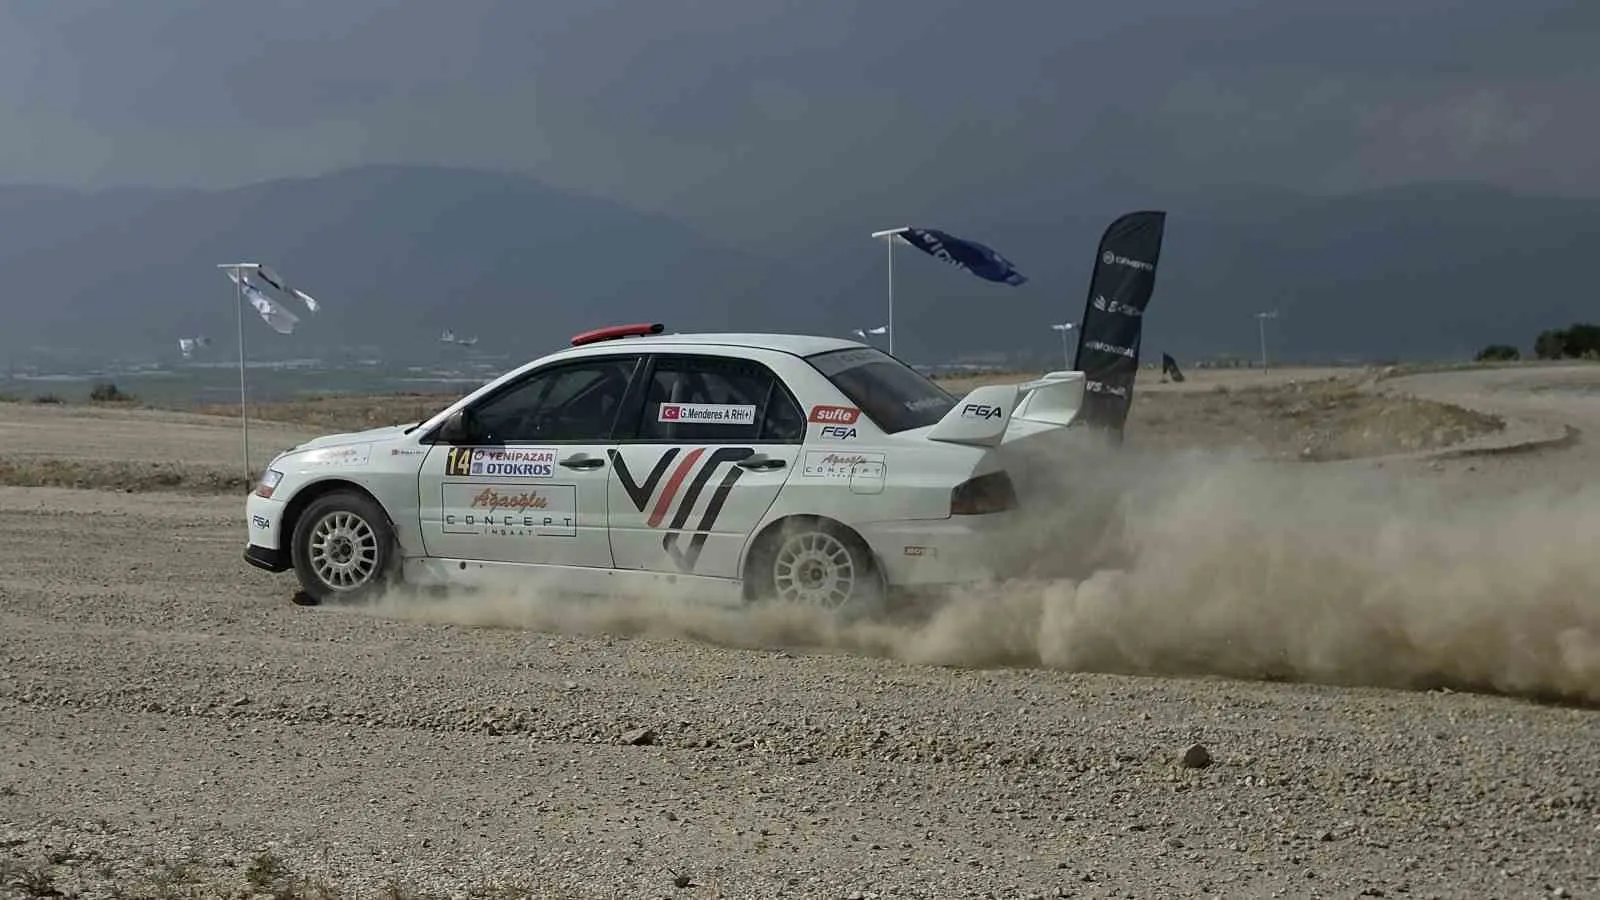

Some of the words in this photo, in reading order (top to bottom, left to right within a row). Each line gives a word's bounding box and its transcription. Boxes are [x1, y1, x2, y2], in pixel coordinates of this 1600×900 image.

[961, 404, 1002, 420] FGA
[820, 426, 857, 440] FGA
[447, 448, 470, 475] 14
[488, 451, 553, 463] YENİPAZAR
[486, 463, 552, 475] OTOKROS
[471, 487, 548, 514] Ağaoğlu
[446, 515, 572, 527] CONCEPT
